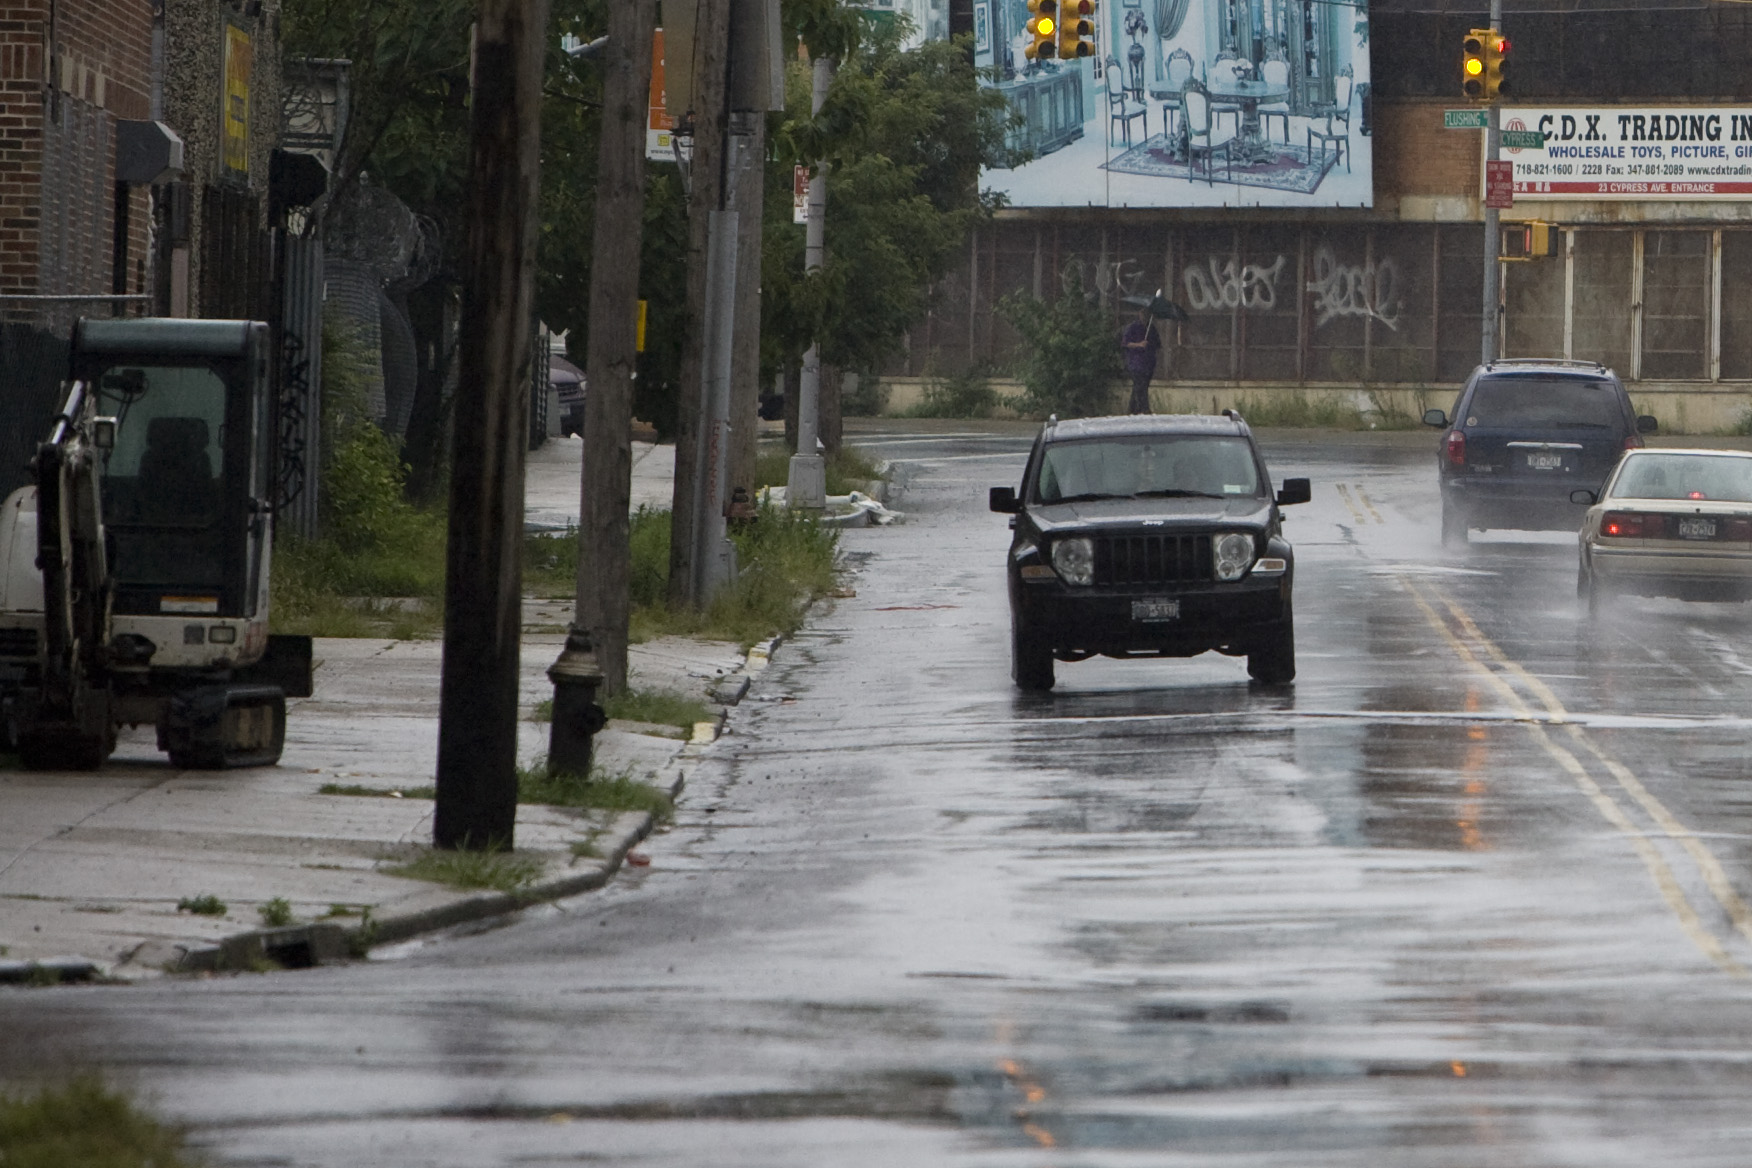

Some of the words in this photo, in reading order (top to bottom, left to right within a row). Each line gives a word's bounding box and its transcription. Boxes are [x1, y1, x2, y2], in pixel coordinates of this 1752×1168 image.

[1444, 112, 1481, 126] FLUSHING
[1539, 114, 1607, 142] C.D.X.
[1618, 114, 1722, 142] TRADING
[1501, 132, 1537, 146] CYPRESS
[1549, 145, 1626, 159] WHOLESALE
[1630, 145, 1666, 160] TOYS,
[1671, 145, 1729, 161] PICTURE,
[1516, 163, 1573, 176] 718-821-1600
[1582, 163, 1603, 176] 2228
[1606, 164, 1624, 176] Fax:
[1598, 183, 1608, 192] 23
[1610, 183, 1648, 193] CYPRESS
[1650, 183, 1669, 192] AVE.
[1671, 183, 1715, 192] ENTRANCE
